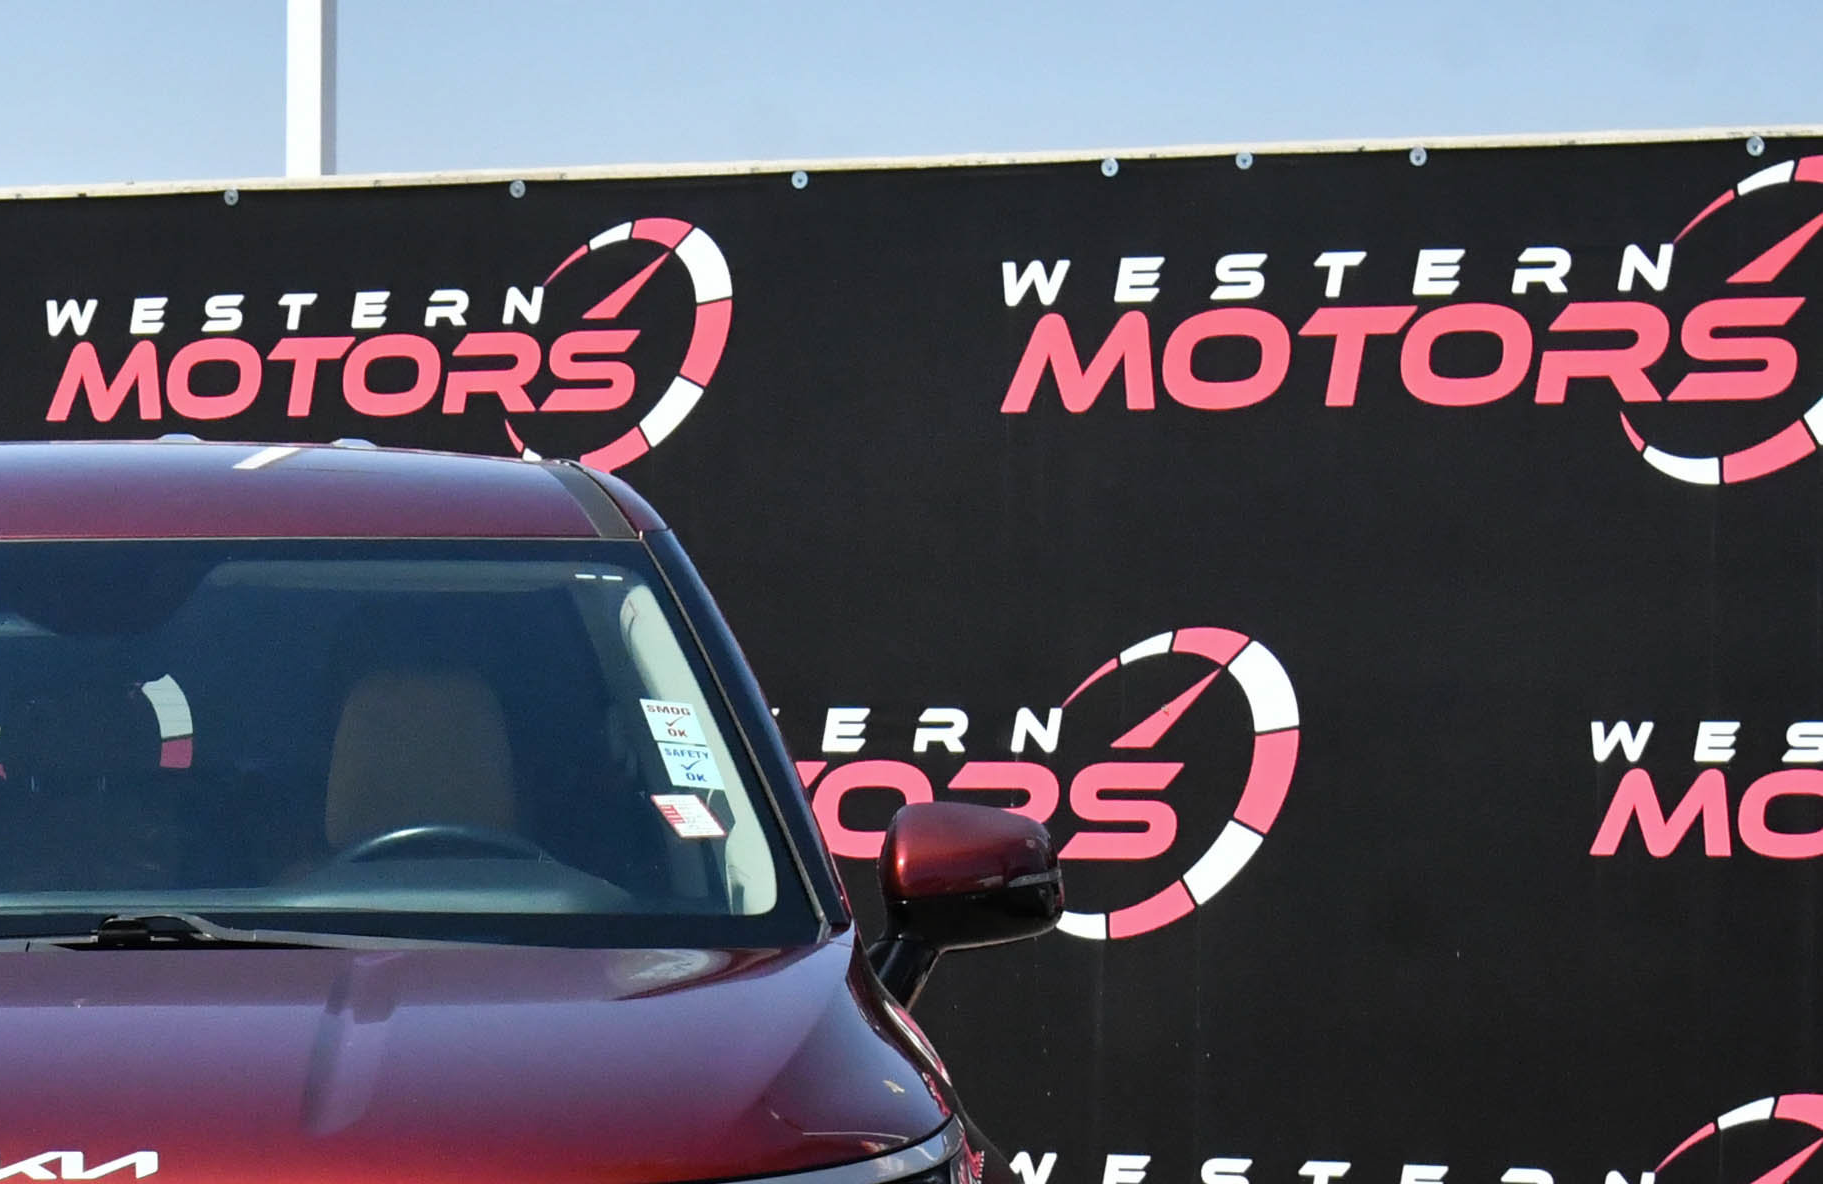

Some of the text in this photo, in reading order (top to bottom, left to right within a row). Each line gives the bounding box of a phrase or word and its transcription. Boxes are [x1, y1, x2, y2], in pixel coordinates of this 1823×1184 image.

[1002, 244, 1674, 306] WESTERN
[46, 287, 544, 336] WESTERN
[47, 330, 640, 422] MOTORS
[1001, 297, 1805, 413] MOTORS
[646, 704, 691, 716] SMOG
[667, 728, 688, 738] OK
[772, 707, 1062, 753] ERN
[664, 747, 709, 760] SAFETY
[686, 772, 707, 782] OK
